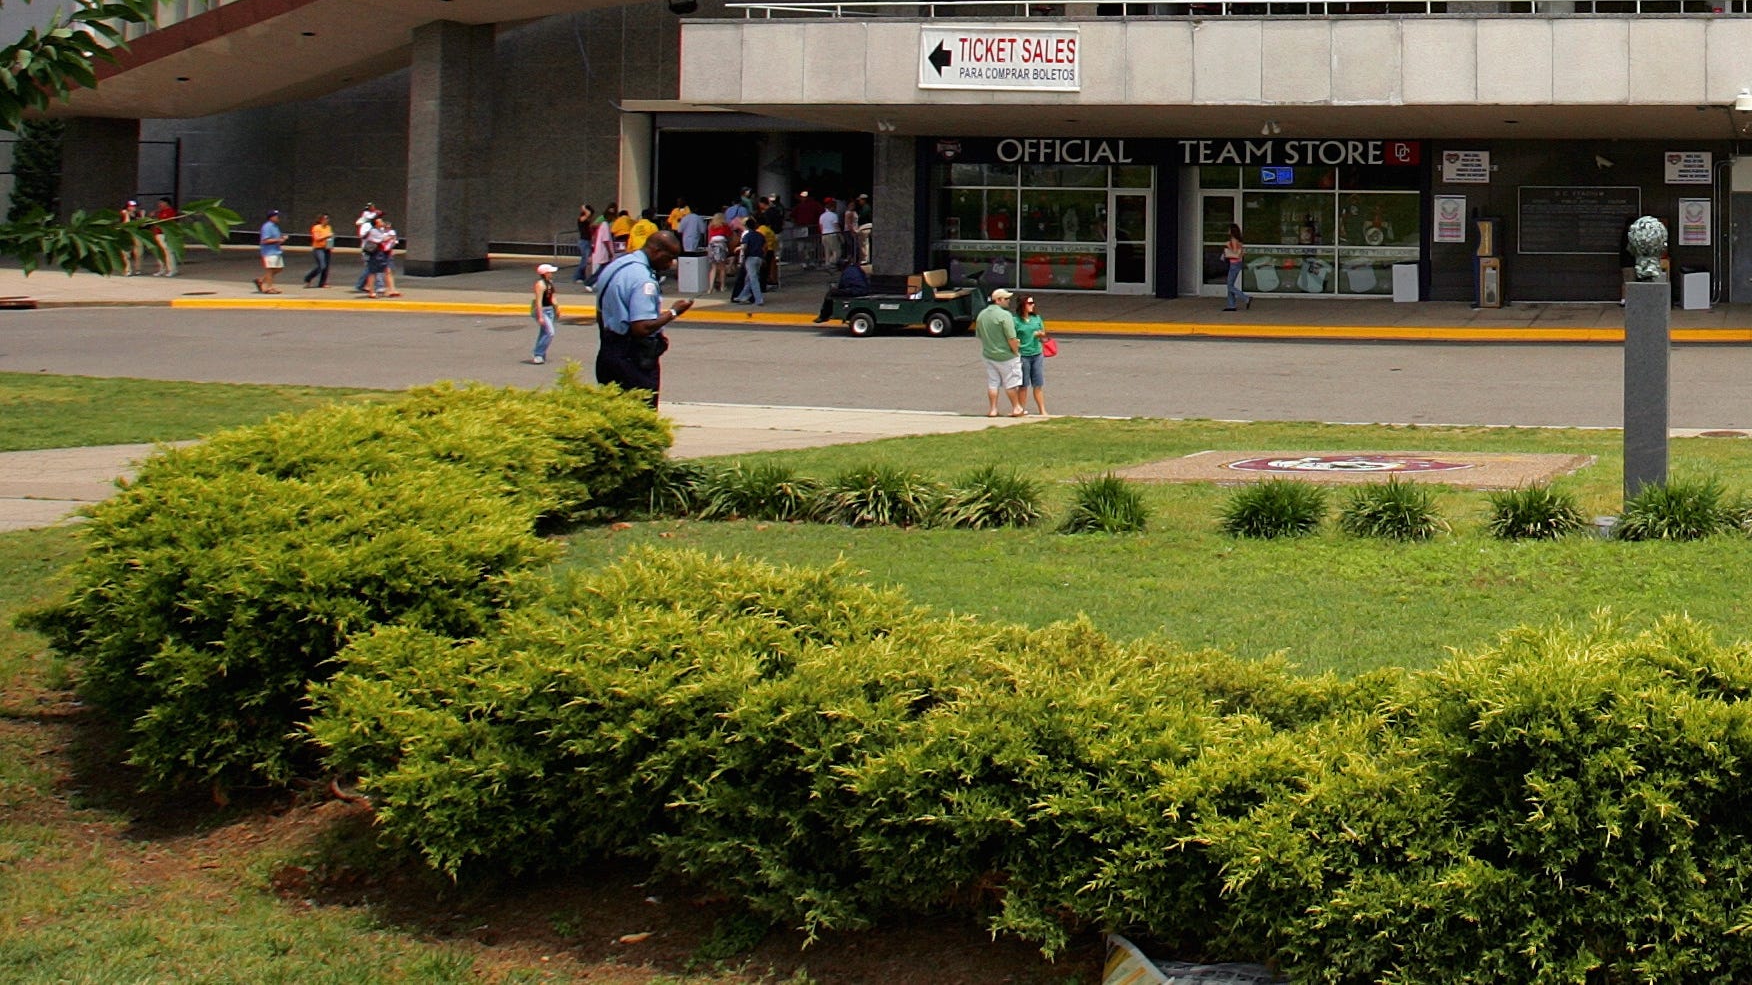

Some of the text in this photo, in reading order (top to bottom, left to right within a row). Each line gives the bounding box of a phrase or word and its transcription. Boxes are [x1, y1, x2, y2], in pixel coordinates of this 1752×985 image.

[959, 37, 1076, 64] TICKET SALES
[959, 67, 1075, 81] PARA COMPRAR BOLETOS
[997, 139, 1385, 165] OFFICIAL TEAM STORE
